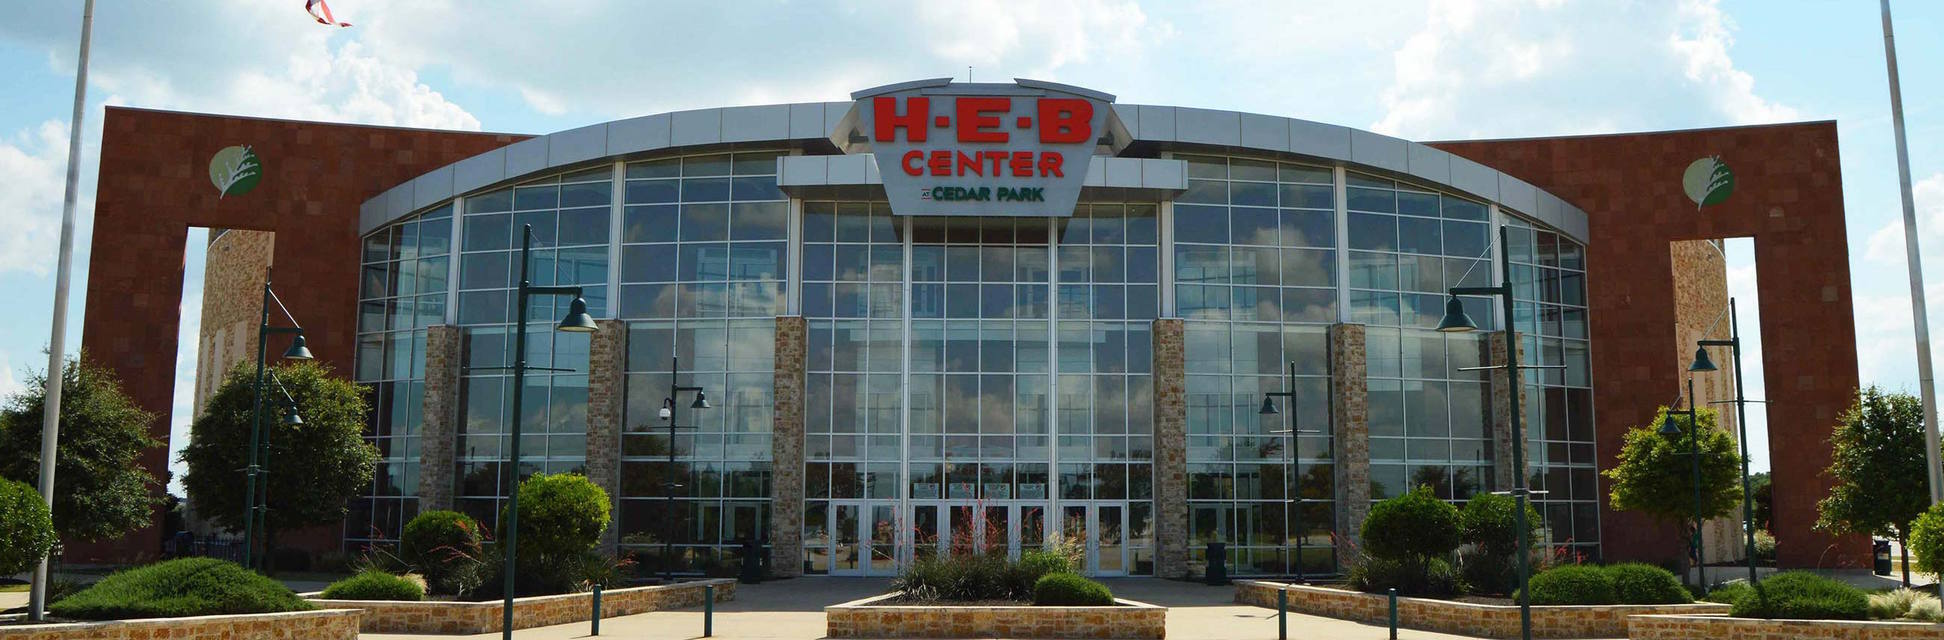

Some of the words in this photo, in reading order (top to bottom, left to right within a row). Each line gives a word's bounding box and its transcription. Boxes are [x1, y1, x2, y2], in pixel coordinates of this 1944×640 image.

[873, 96, 1094, 144] H-E-B
[902, 150, 1064, 177] CENTER
[932, 186, 991, 202] CEDAR
[996, 186, 1045, 202] PARK
